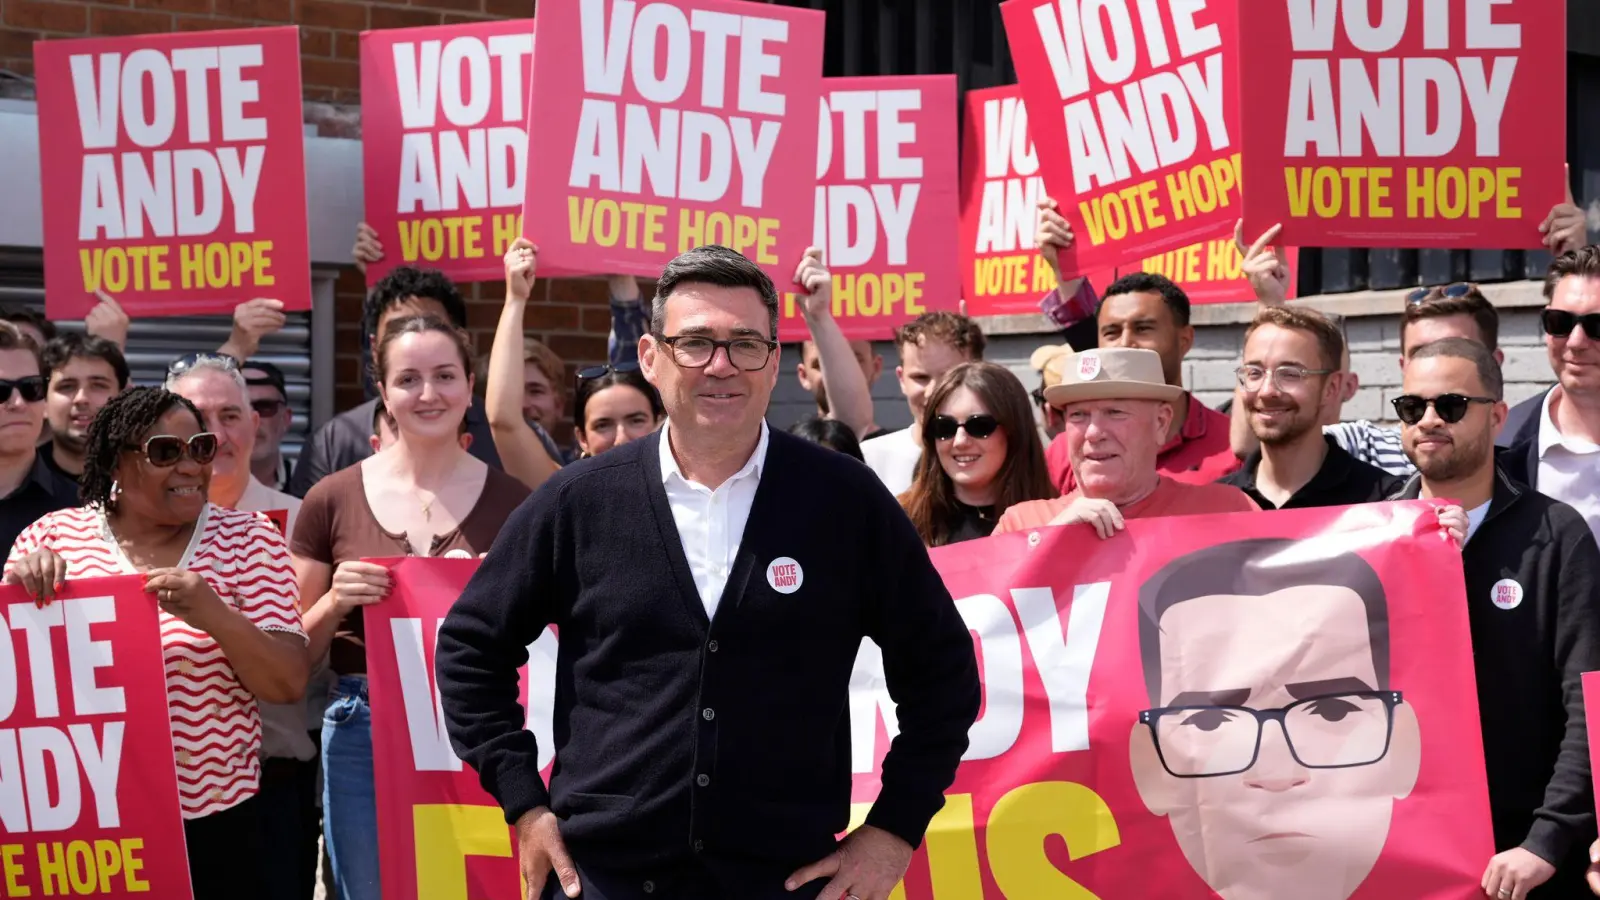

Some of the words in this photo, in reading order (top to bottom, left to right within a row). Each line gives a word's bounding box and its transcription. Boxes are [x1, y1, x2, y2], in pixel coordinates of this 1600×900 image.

[392, 33, 534, 129] VOT
[580, 0, 789, 116] VOTE
[1033, 0, 1222, 100] VOTE
[69, 44, 267, 149] VOTE
[816, 89, 923, 180] TE
[1063, 52, 1229, 195] ANDY
[1284, 56, 1518, 157] ANDY
[397, 126, 528, 214] AND
[568, 98, 782, 208] ANDY
[984, 97, 1040, 176] VO
[78, 145, 266, 241] ANDY
[568, 196, 667, 252] VOTE
[678, 208, 780, 265] HOPE
[812, 183, 921, 267] DY
[975, 176, 1048, 254] AN
[1079, 180, 1167, 246] VOTE
[1284, 166, 1394, 218] VOTE
[1406, 166, 1522, 219] HOPE
[79, 245, 171, 293] VOTE
[180, 240, 275, 289] HOPE
[398, 216, 484, 262] VOTE
[974, 256, 1029, 296] VOTE
[1206, 239, 1248, 281] HO
[831, 272, 926, 317] HOPE
[772, 564, 797, 577] VOTE
[775, 575, 797, 588] ANDY
[1496, 595, 1516, 604] ANDY
[1497, 585, 1517, 595] VOTE
[0, 596, 127, 722] TE
[0, 721, 125, 833] DY
[36, 837, 150, 896] HOPE
